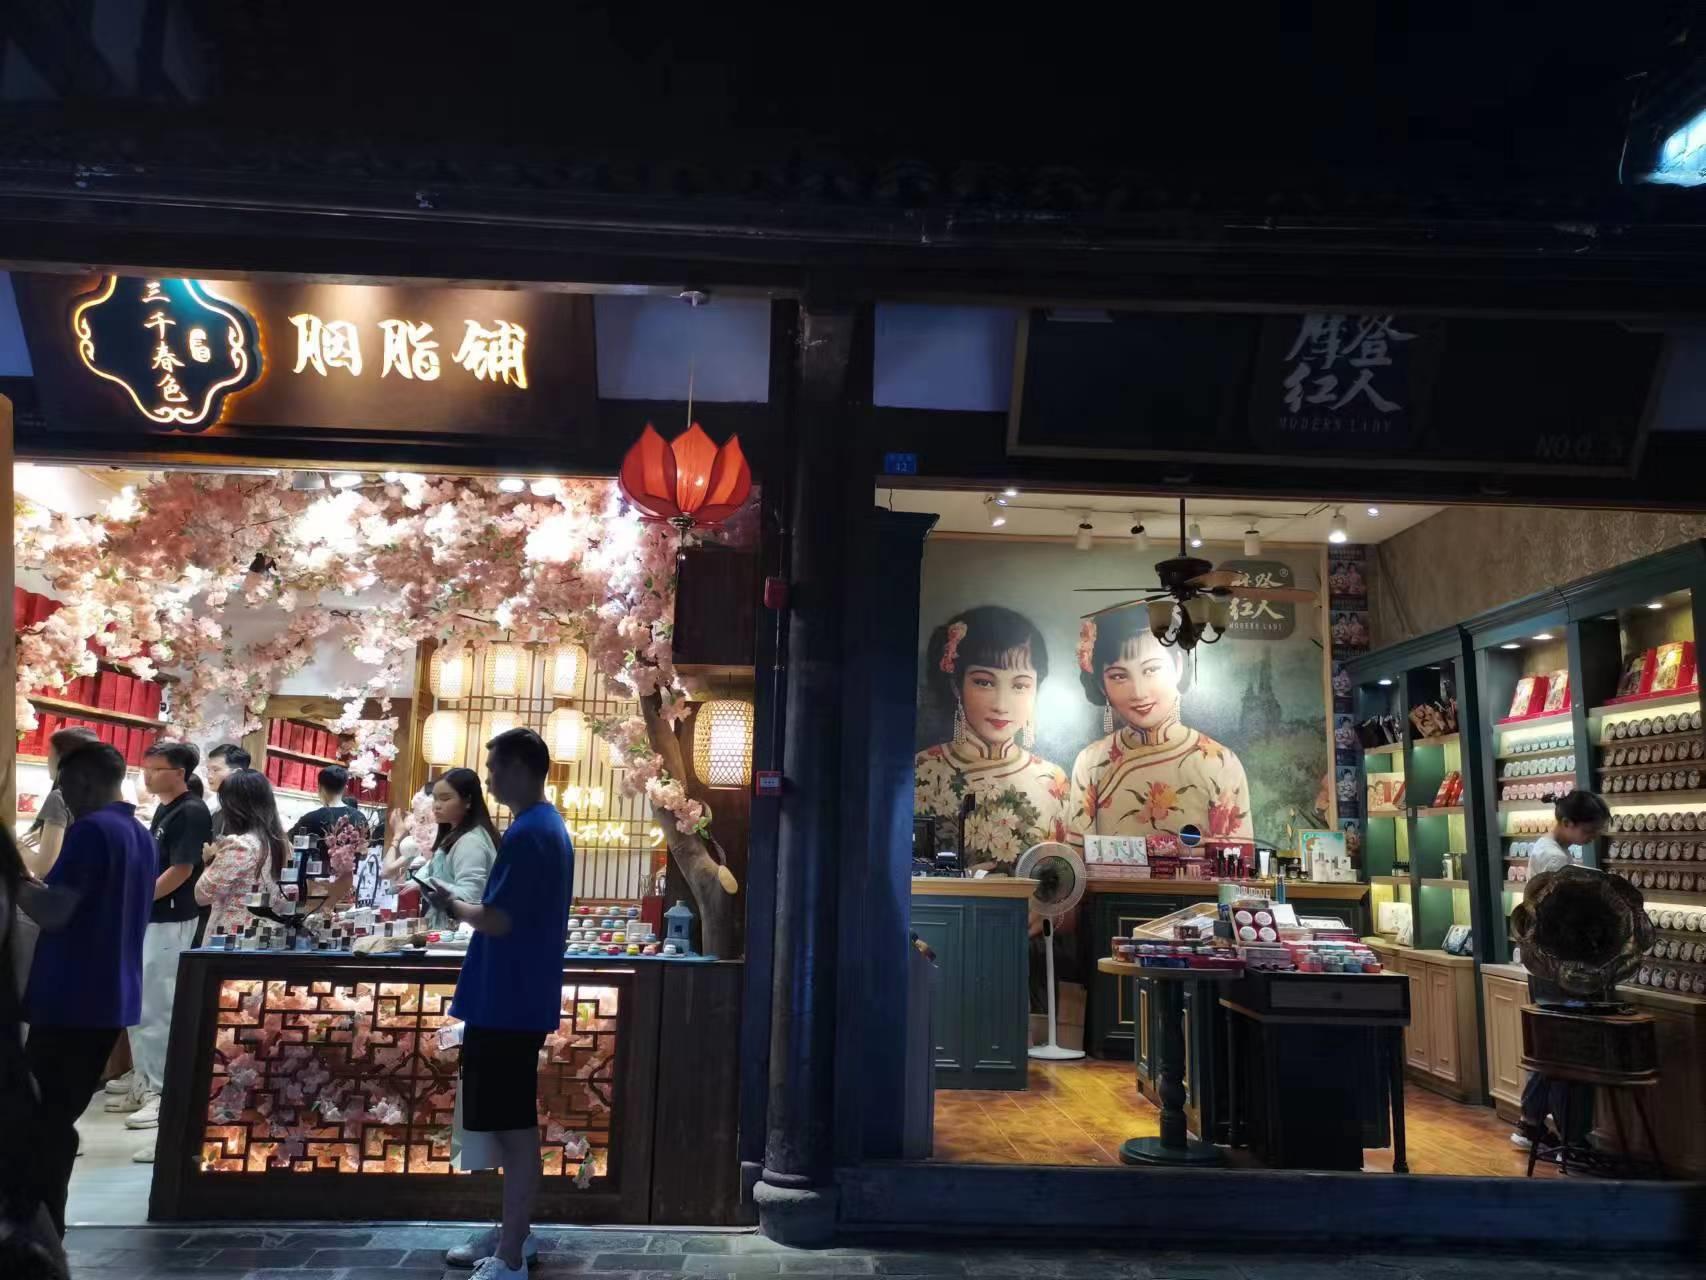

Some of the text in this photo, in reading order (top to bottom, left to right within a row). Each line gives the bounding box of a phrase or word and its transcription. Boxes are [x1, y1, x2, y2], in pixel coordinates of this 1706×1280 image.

[141, 281, 188, 402] 三千春色
[1282, 362, 1402, 412] 红人
[1229, 597, 1285, 620] 红人
